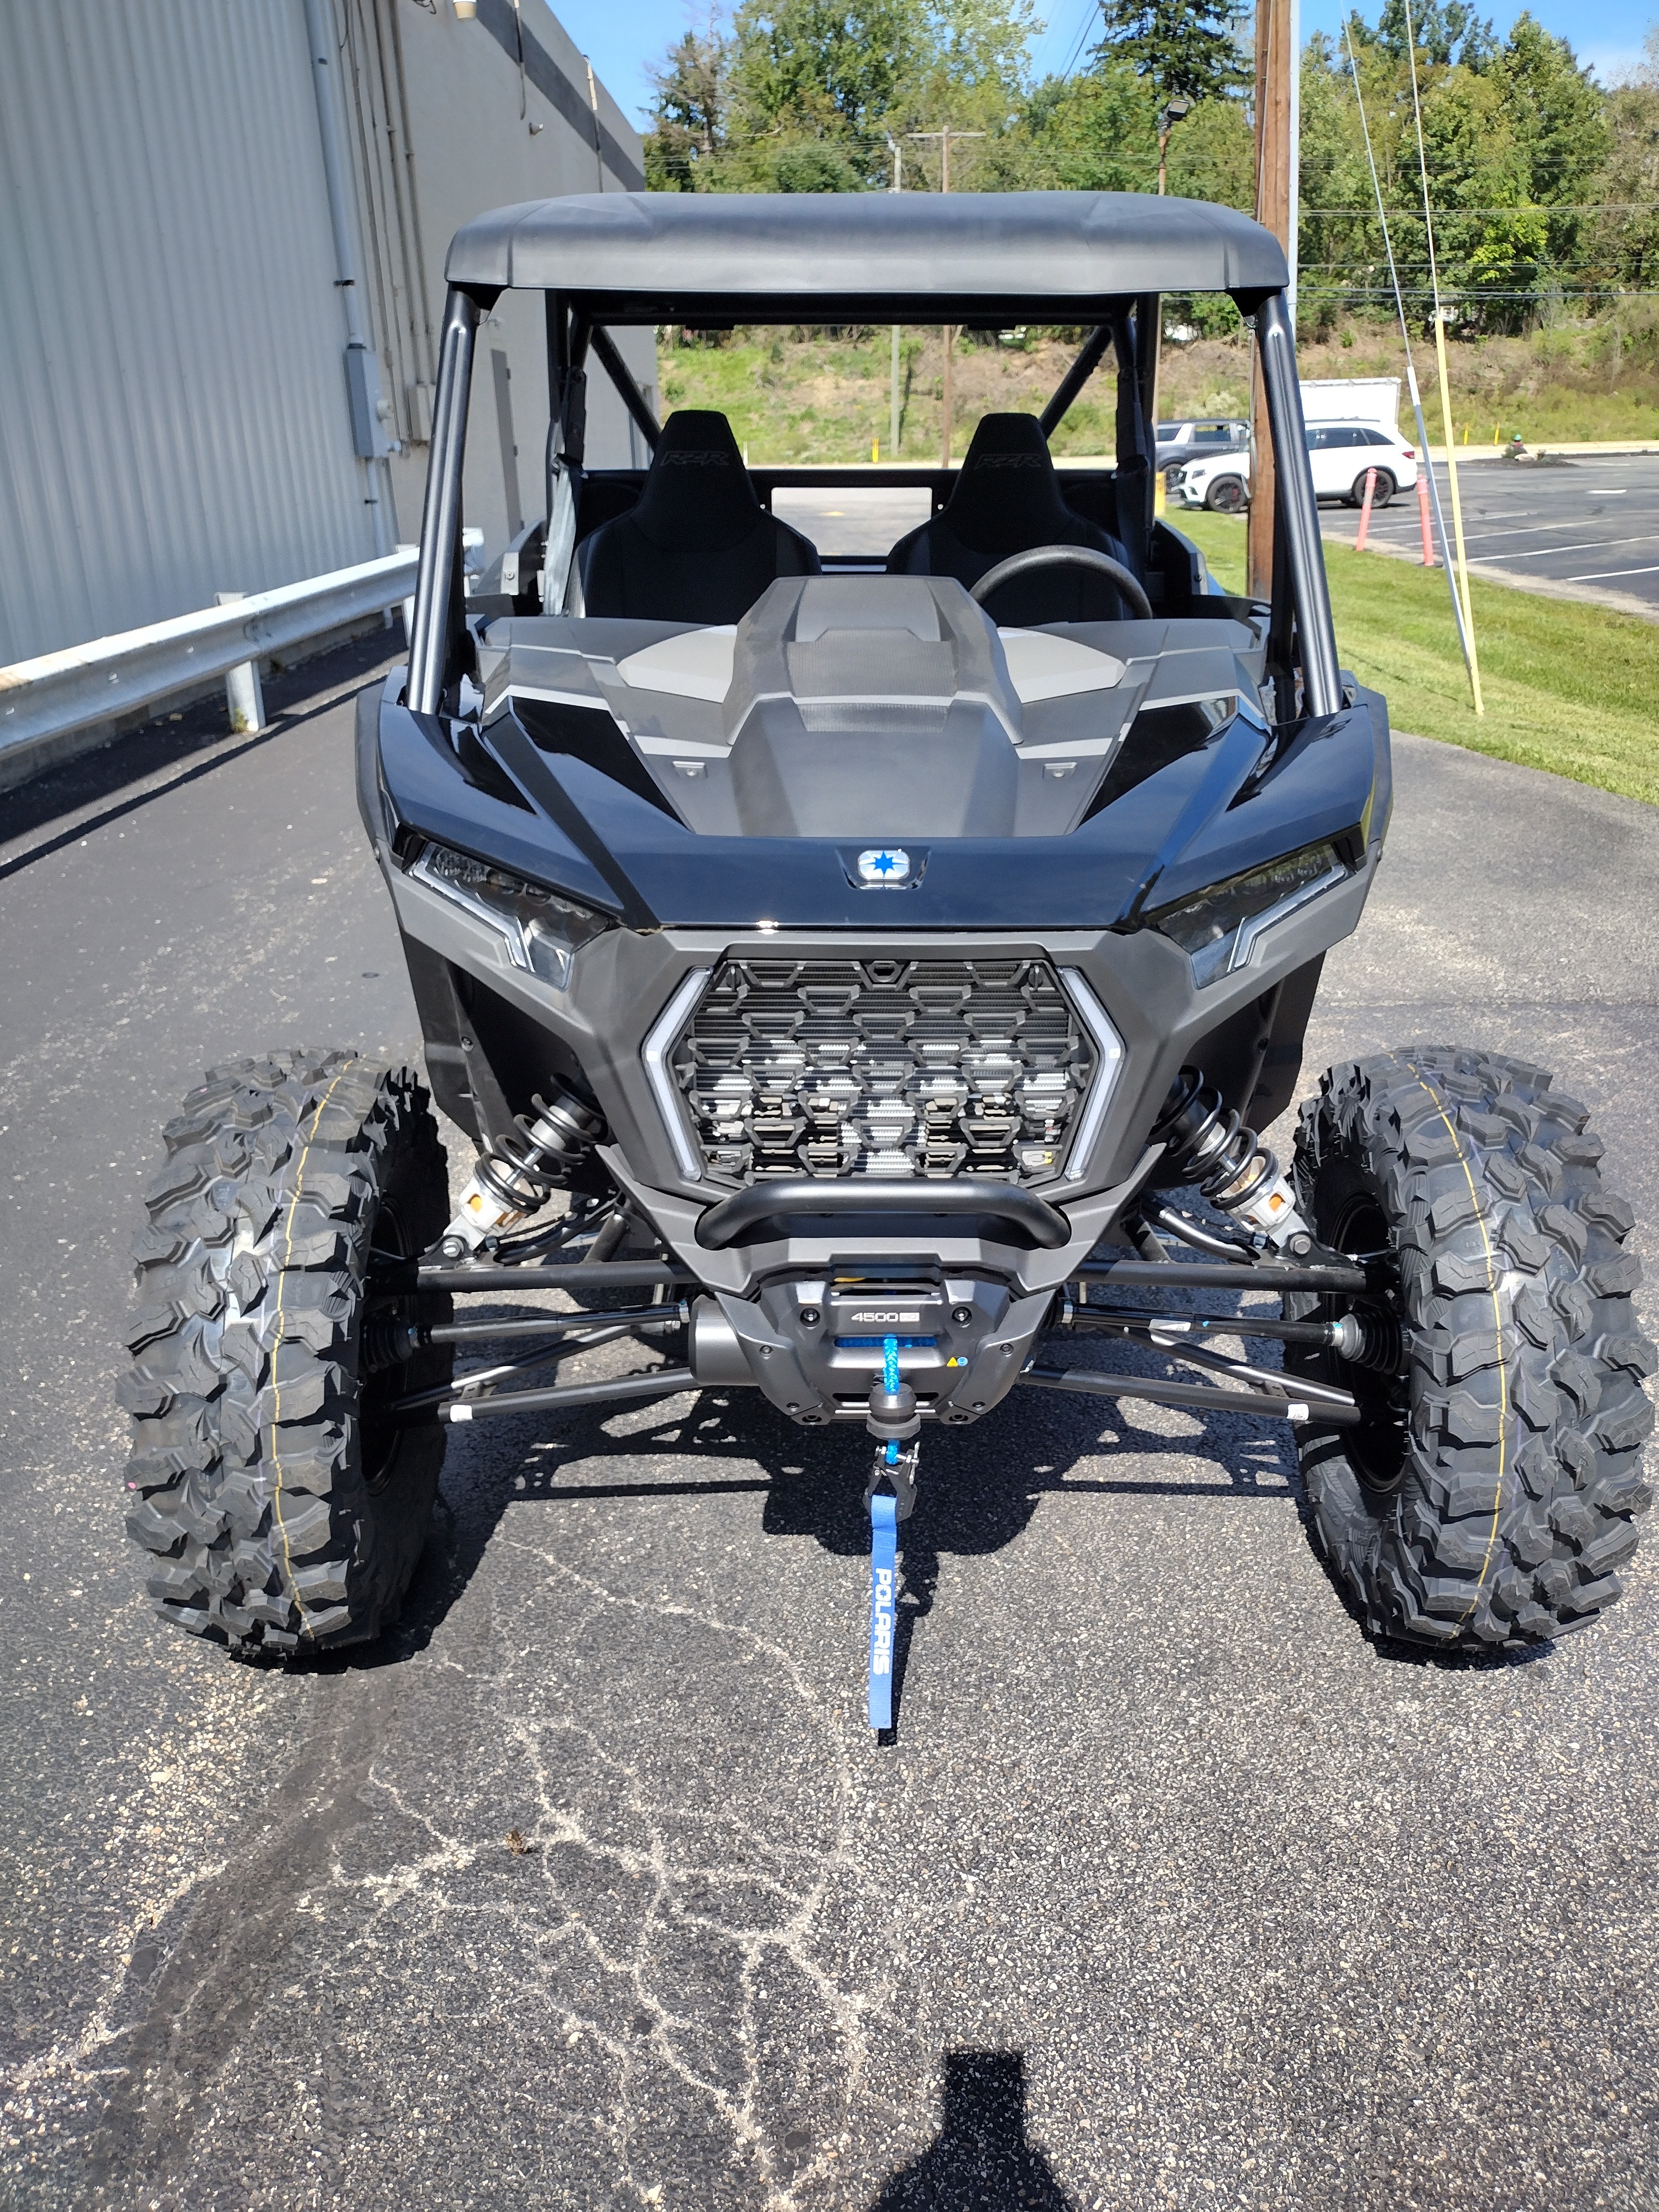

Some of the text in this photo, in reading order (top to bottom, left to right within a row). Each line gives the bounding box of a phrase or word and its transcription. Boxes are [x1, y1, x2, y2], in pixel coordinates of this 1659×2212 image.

[660, 451, 729, 466] RZR
[973, 453, 1042, 469] RZR
[851, 1312, 899, 1322] 4500
[873, 1568, 892, 1675] POLARIS
